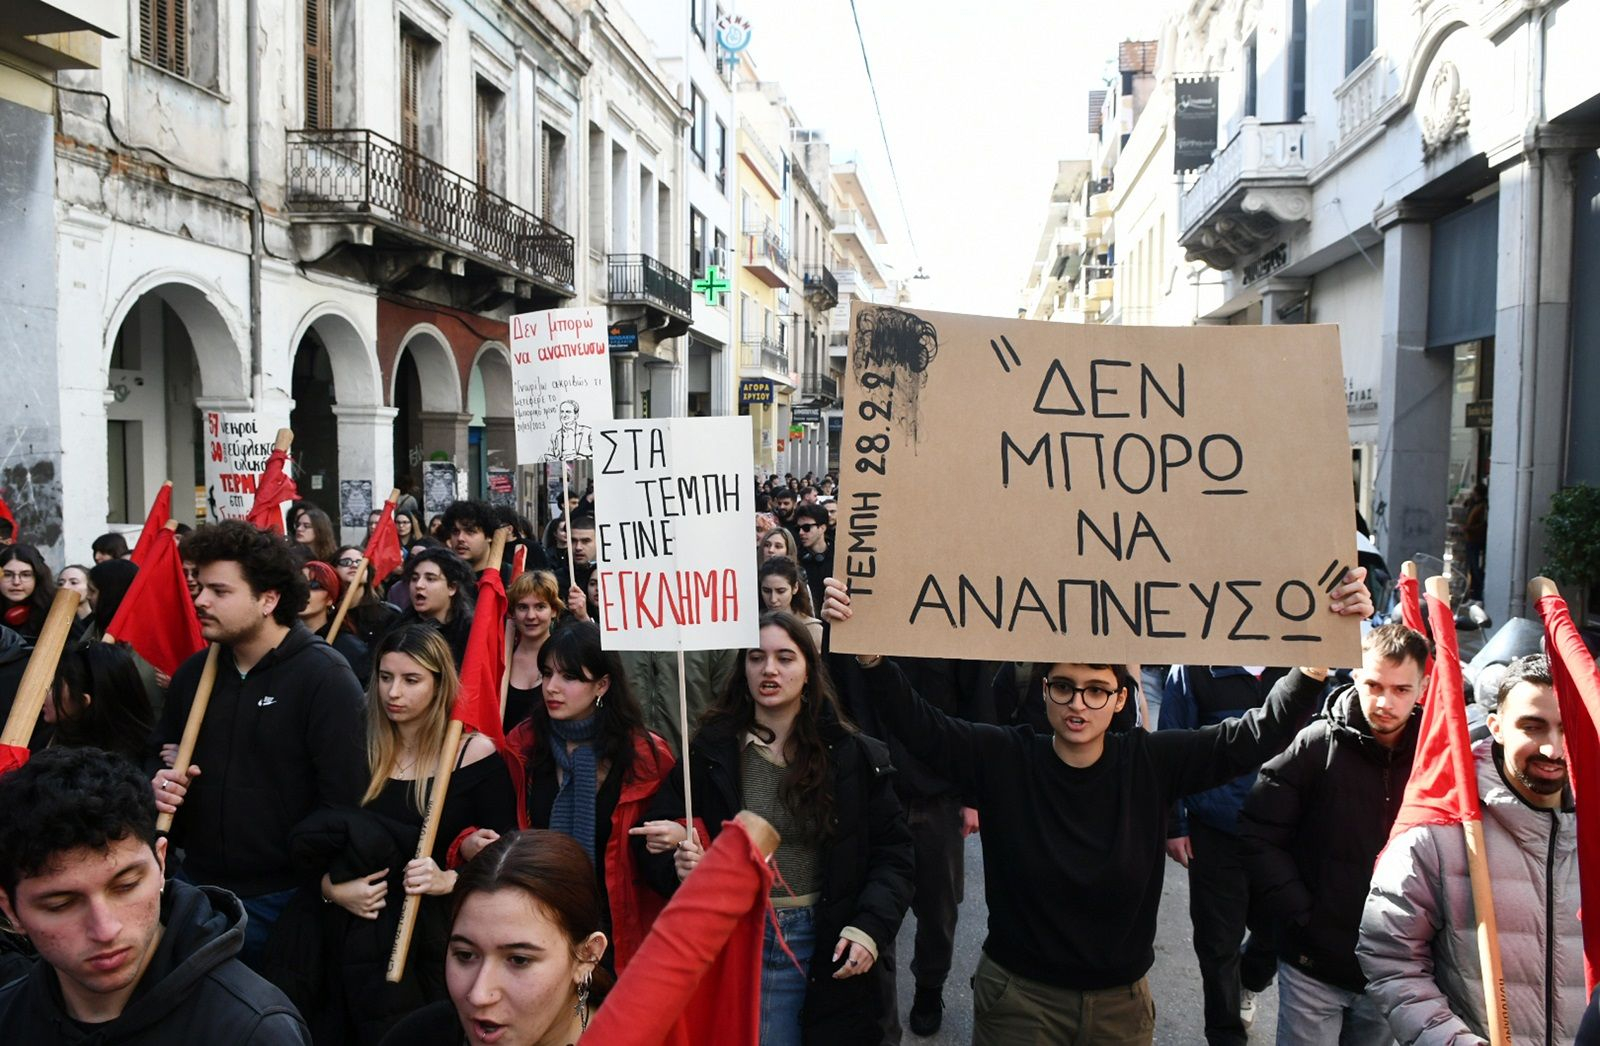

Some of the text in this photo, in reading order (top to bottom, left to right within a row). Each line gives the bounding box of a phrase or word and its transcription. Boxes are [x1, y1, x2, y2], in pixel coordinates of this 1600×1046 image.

[514, 316, 537, 340] Δεν
[547, 311, 594, 341] μπορώ
[514, 352, 531, 365] να
[743, 383, 770, 391] ΑΓΟΡΑ
[743, 392, 770, 400] ΧΡΥΣΟΥ
[208, 412, 258, 438] 57 νεκροί
[211, 441, 223, 462] 30
[599, 428, 666, 474] ΣΤΑ
[1002, 431, 1248, 495] ΜΠΟΡΩ
[219, 473, 262, 494] ΤΕΡΜ
[635, 473, 740, 517] ΤΕΜΠΗ
[599, 519, 673, 562] ΕΓΙΝΕ
[846, 492, 881, 595] ΤΕΜΠΗ
[1077, 508, 1171, 563] ΝΑ
[601, 568, 738, 632] ΕΓΚΛΗΜΑ
